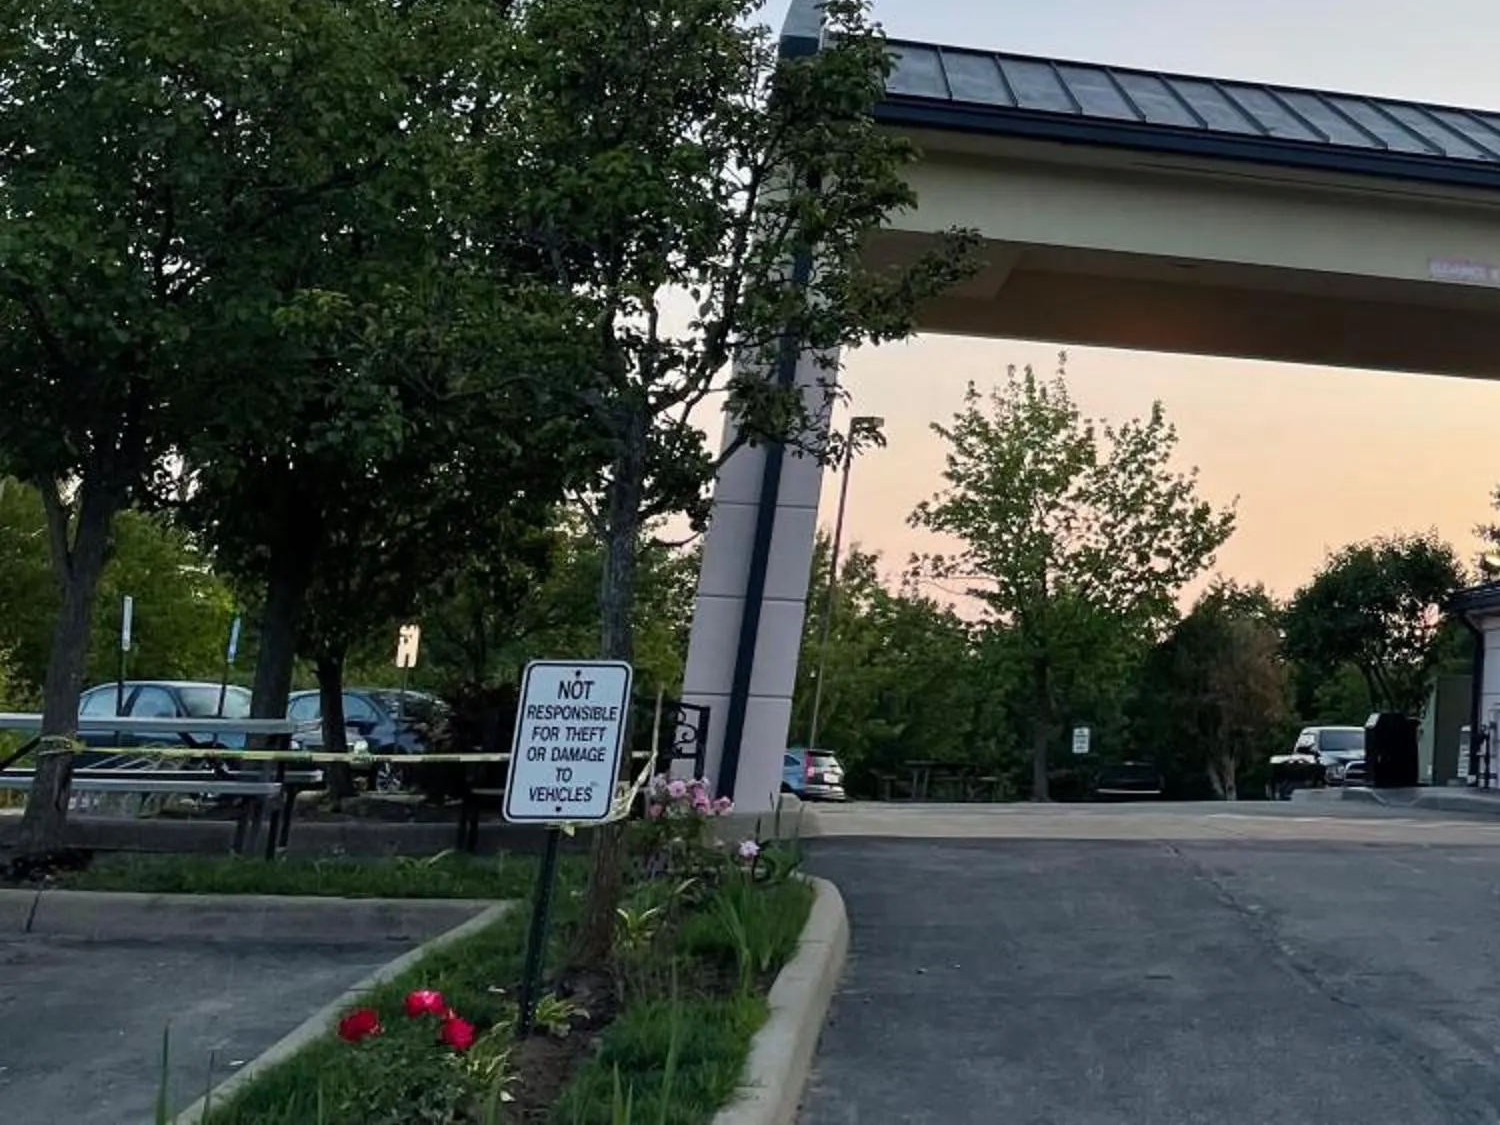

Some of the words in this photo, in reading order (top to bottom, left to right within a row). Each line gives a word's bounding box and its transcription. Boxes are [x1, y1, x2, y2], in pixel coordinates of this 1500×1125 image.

[557, 680, 594, 700] NOT
[527, 704, 618, 722] RESPONSIBLE
[531, 726, 558, 742] FOR
[565, 726, 607, 742] THEFT
[527, 746, 546, 762] OR
[551, 746, 607, 762] DAMAGE
[556, 767, 573, 783] TO
[529, 786, 592, 802] VEHICLES
